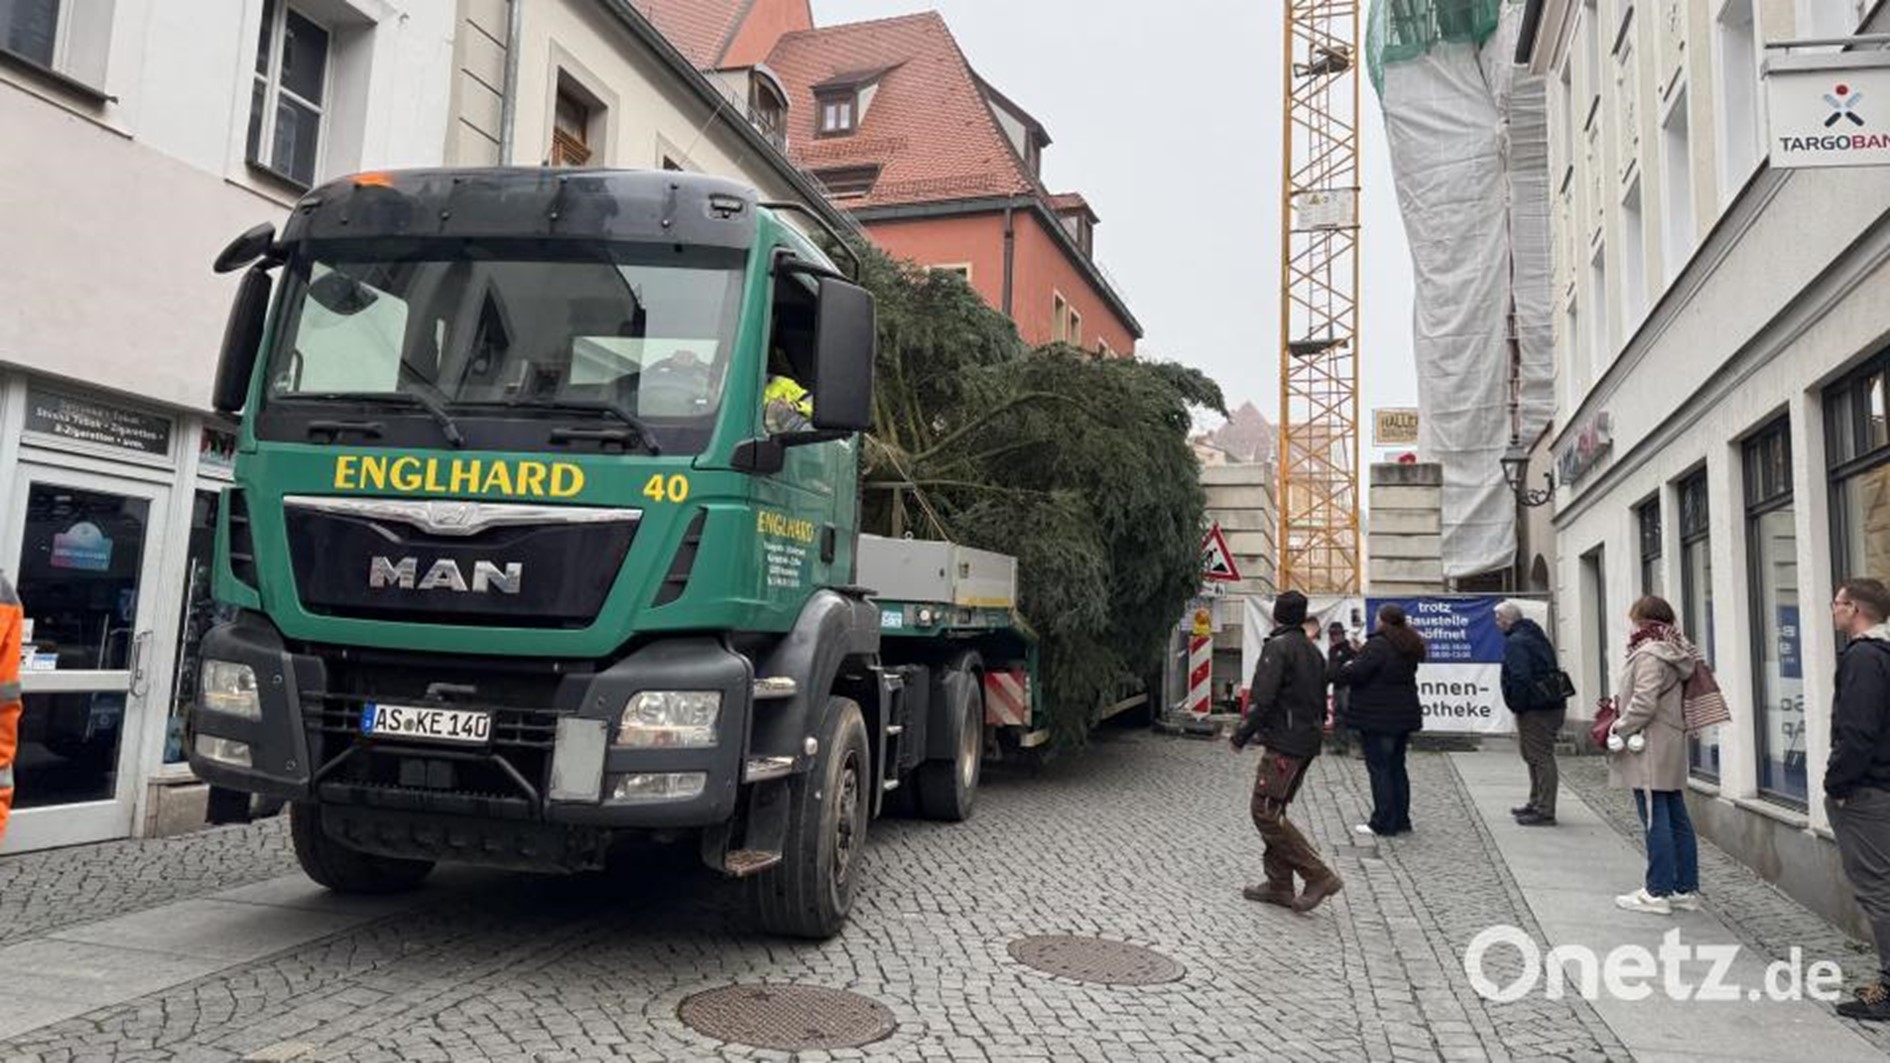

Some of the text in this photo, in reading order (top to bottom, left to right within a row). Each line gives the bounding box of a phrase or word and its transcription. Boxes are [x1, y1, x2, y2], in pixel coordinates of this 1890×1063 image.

[334, 456, 585, 497] ENGLHARD
[643, 474, 689, 502] 40
[757, 511, 815, 543] ENGLHARD
[369, 556, 523, 593] MAN
[1418, 602, 1452, 613] trotz
[1417, 627, 1467, 639] öffnet
[1419, 682, 1489, 696] nnen-
[375, 708, 489, 738] AS KE 140
[1420, 701, 1491, 718] otheke
